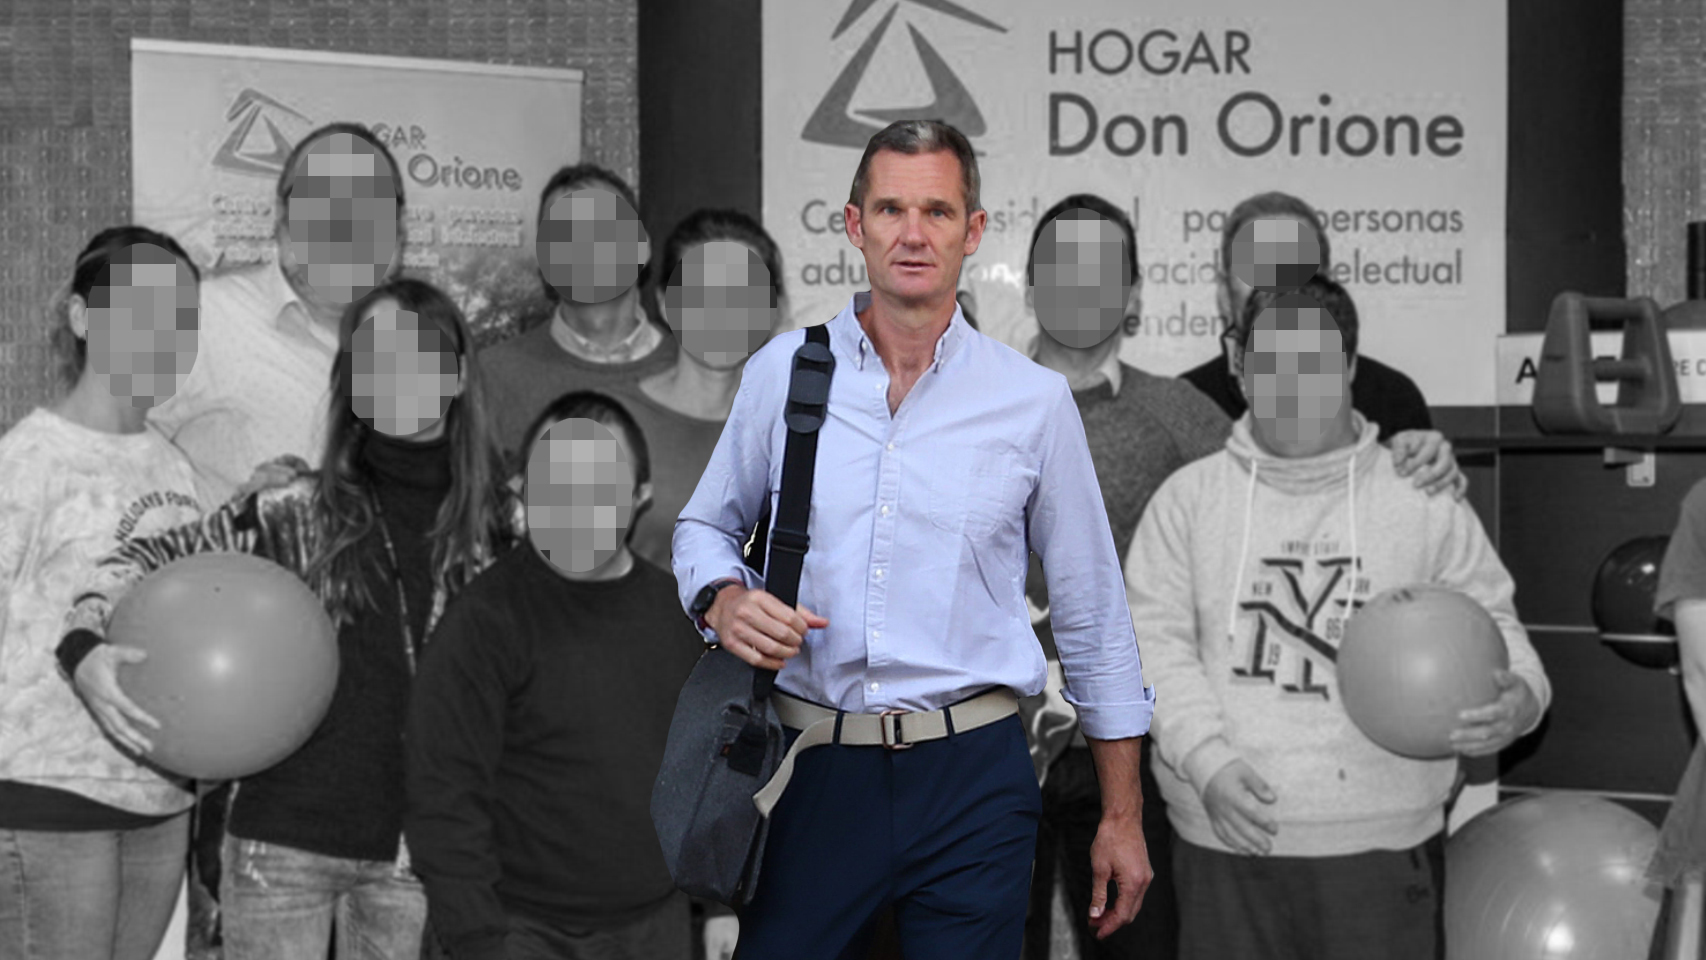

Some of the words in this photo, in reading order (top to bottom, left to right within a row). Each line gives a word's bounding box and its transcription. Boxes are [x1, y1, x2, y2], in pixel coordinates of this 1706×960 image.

[1049, 29, 1251, 75] HOGAR
[371, 122, 427, 150] GAR
[1049, 91, 1188, 157] Don
[1217, 91, 1464, 157] Orione
[408, 153, 524, 192] Orione
[1330, 248, 1463, 286] electual
